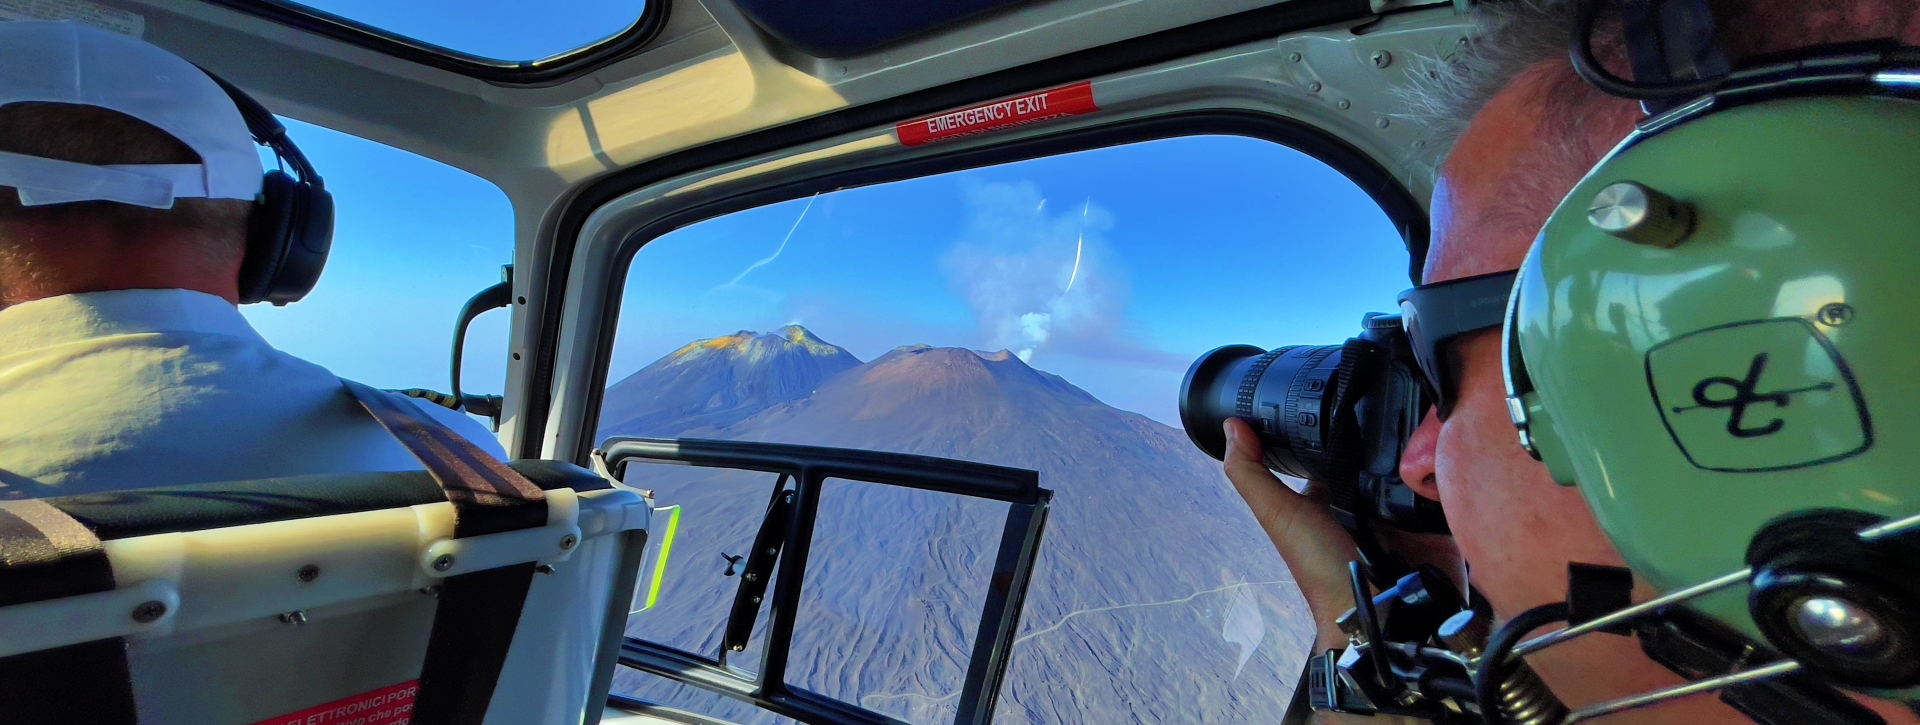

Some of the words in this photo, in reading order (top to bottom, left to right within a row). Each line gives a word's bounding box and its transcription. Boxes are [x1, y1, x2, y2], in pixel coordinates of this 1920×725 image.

[927, 103, 1013, 133] EMERGENCY
[1016, 93, 1048, 115] EXIT
[368, 709, 391, 722] che
